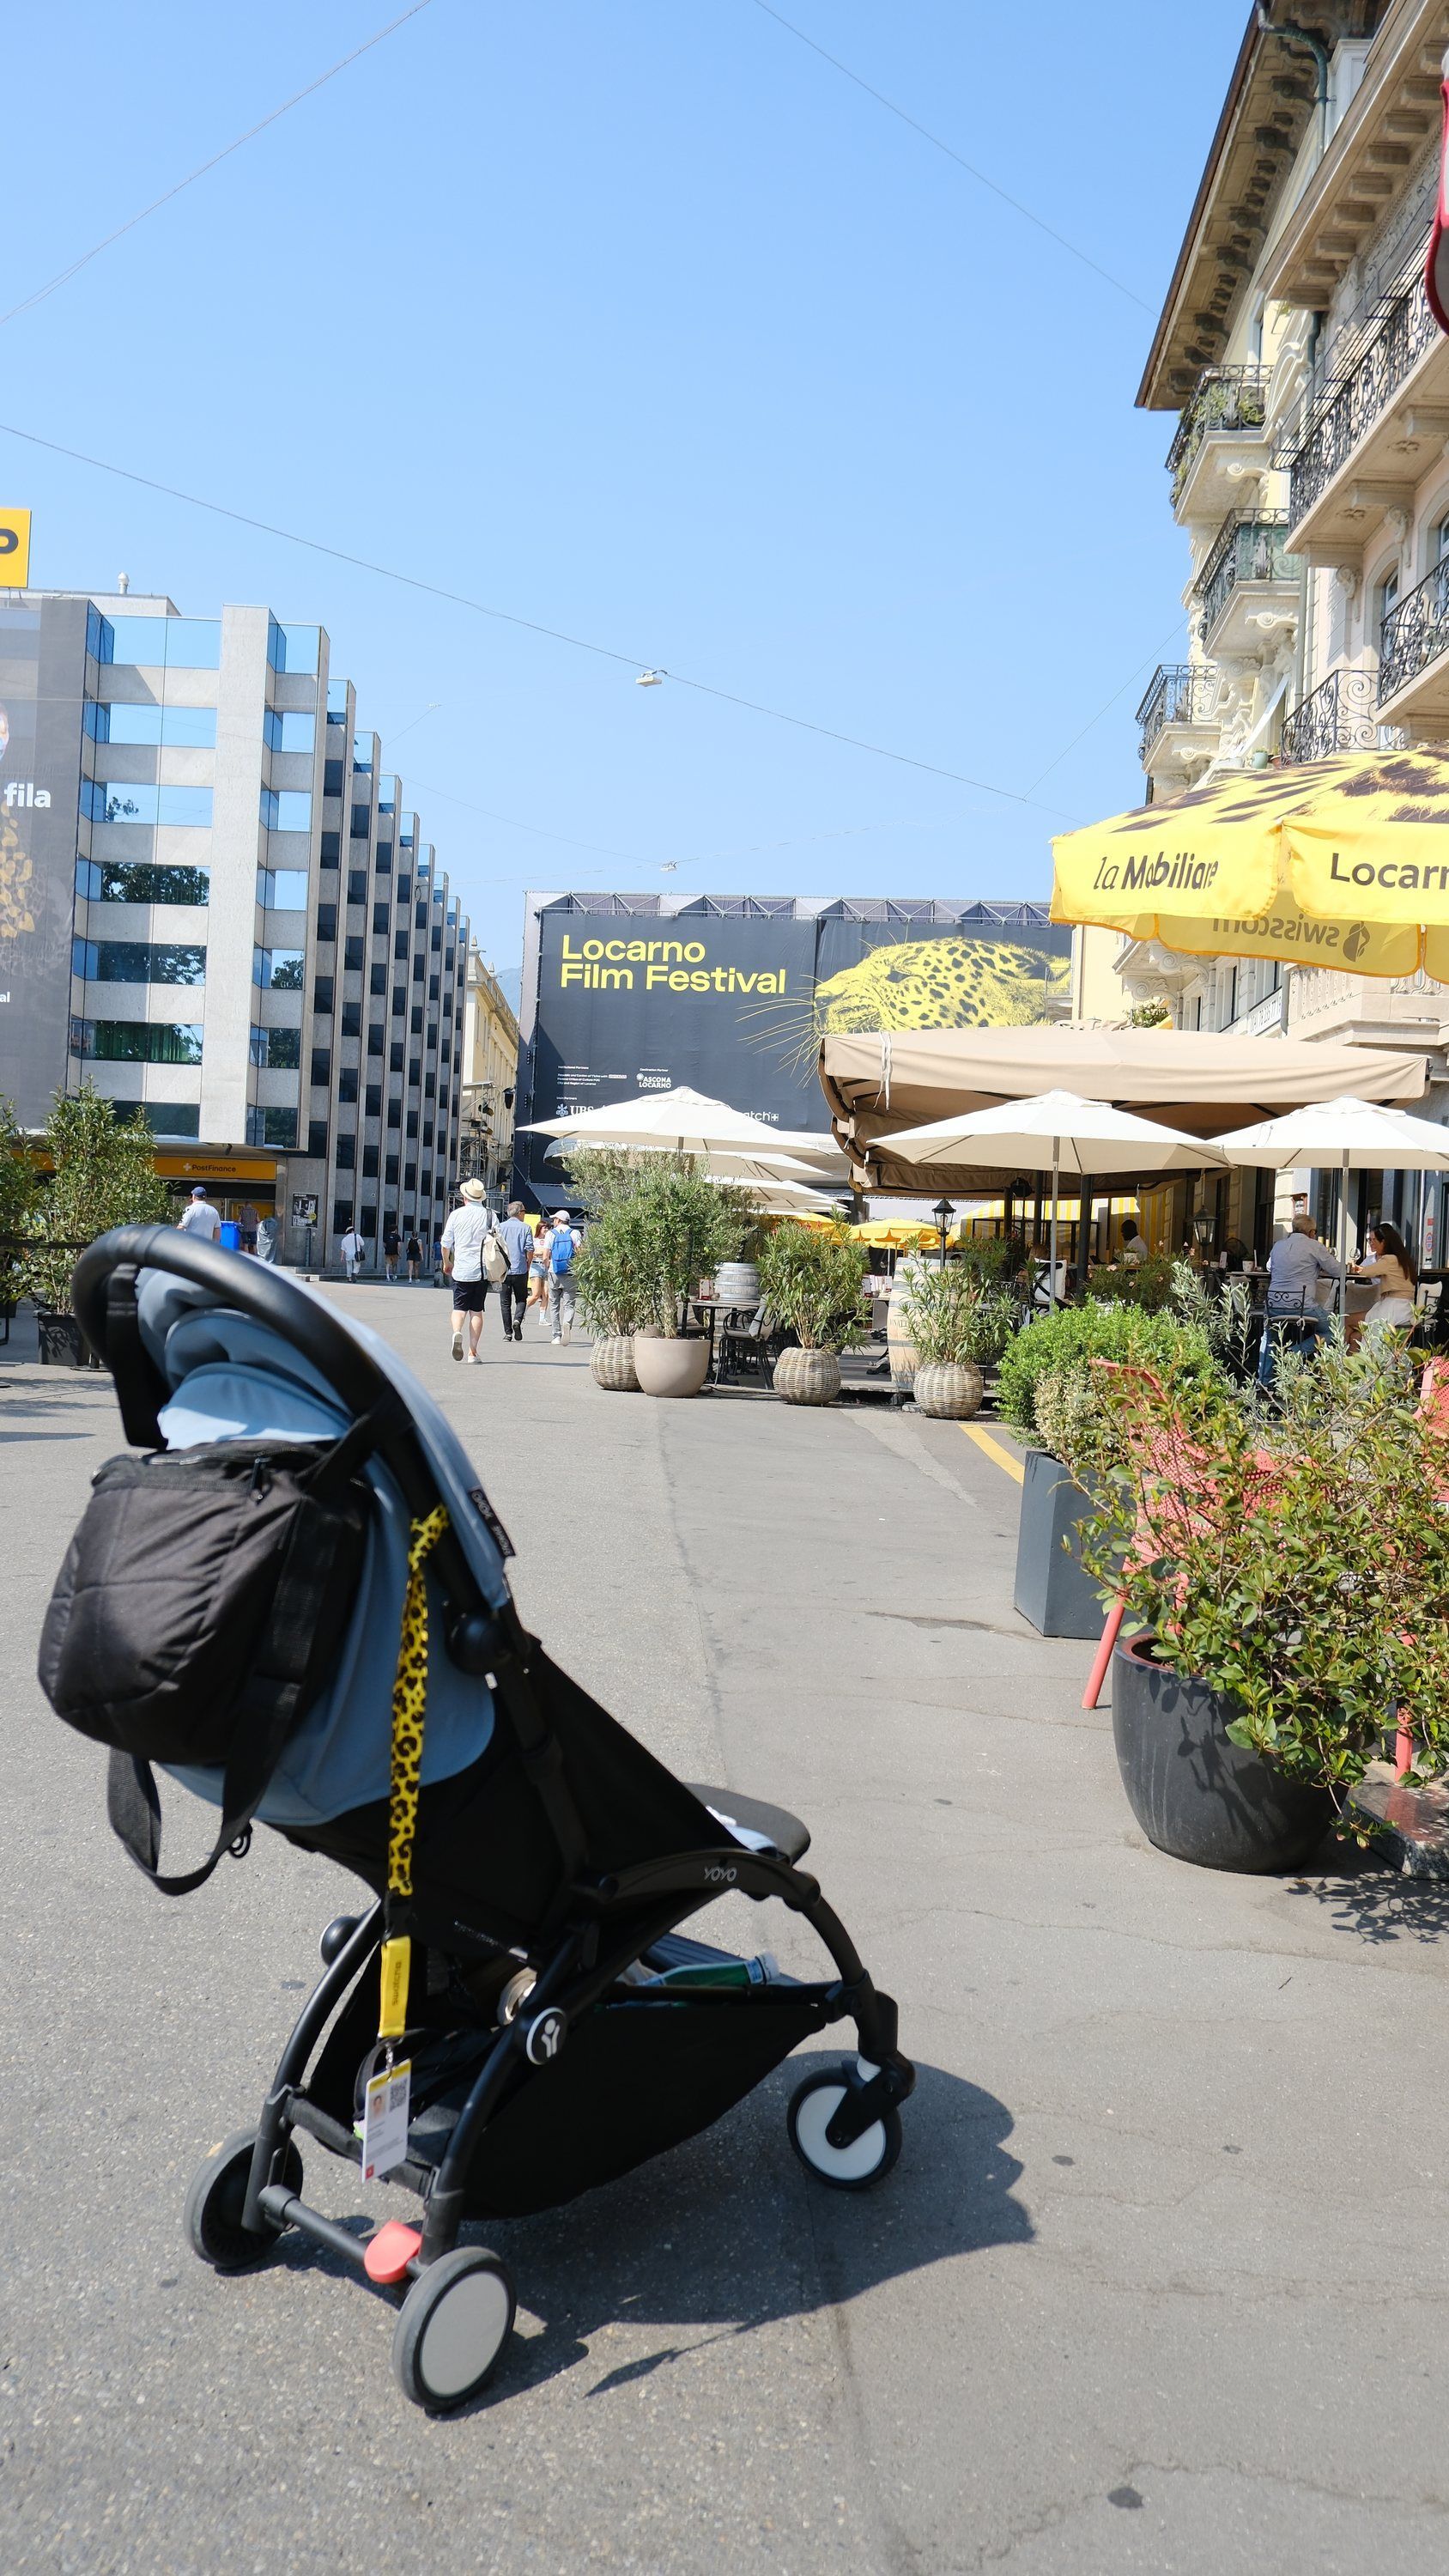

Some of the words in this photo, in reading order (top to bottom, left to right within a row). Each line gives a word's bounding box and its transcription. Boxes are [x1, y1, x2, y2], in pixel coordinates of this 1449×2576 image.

[4, 782, 52, 808] fila
[1093, 856, 1119, 890] la
[1120, 851, 1219, 890] Mobiliare
[561, 934, 706, 963] Locarno
[561, 963, 634, 990] Film
[646, 964, 786, 994] Festival
[191, 1163, 236, 1173] PostFinance
[704, 1866, 737, 1882] YOYO
